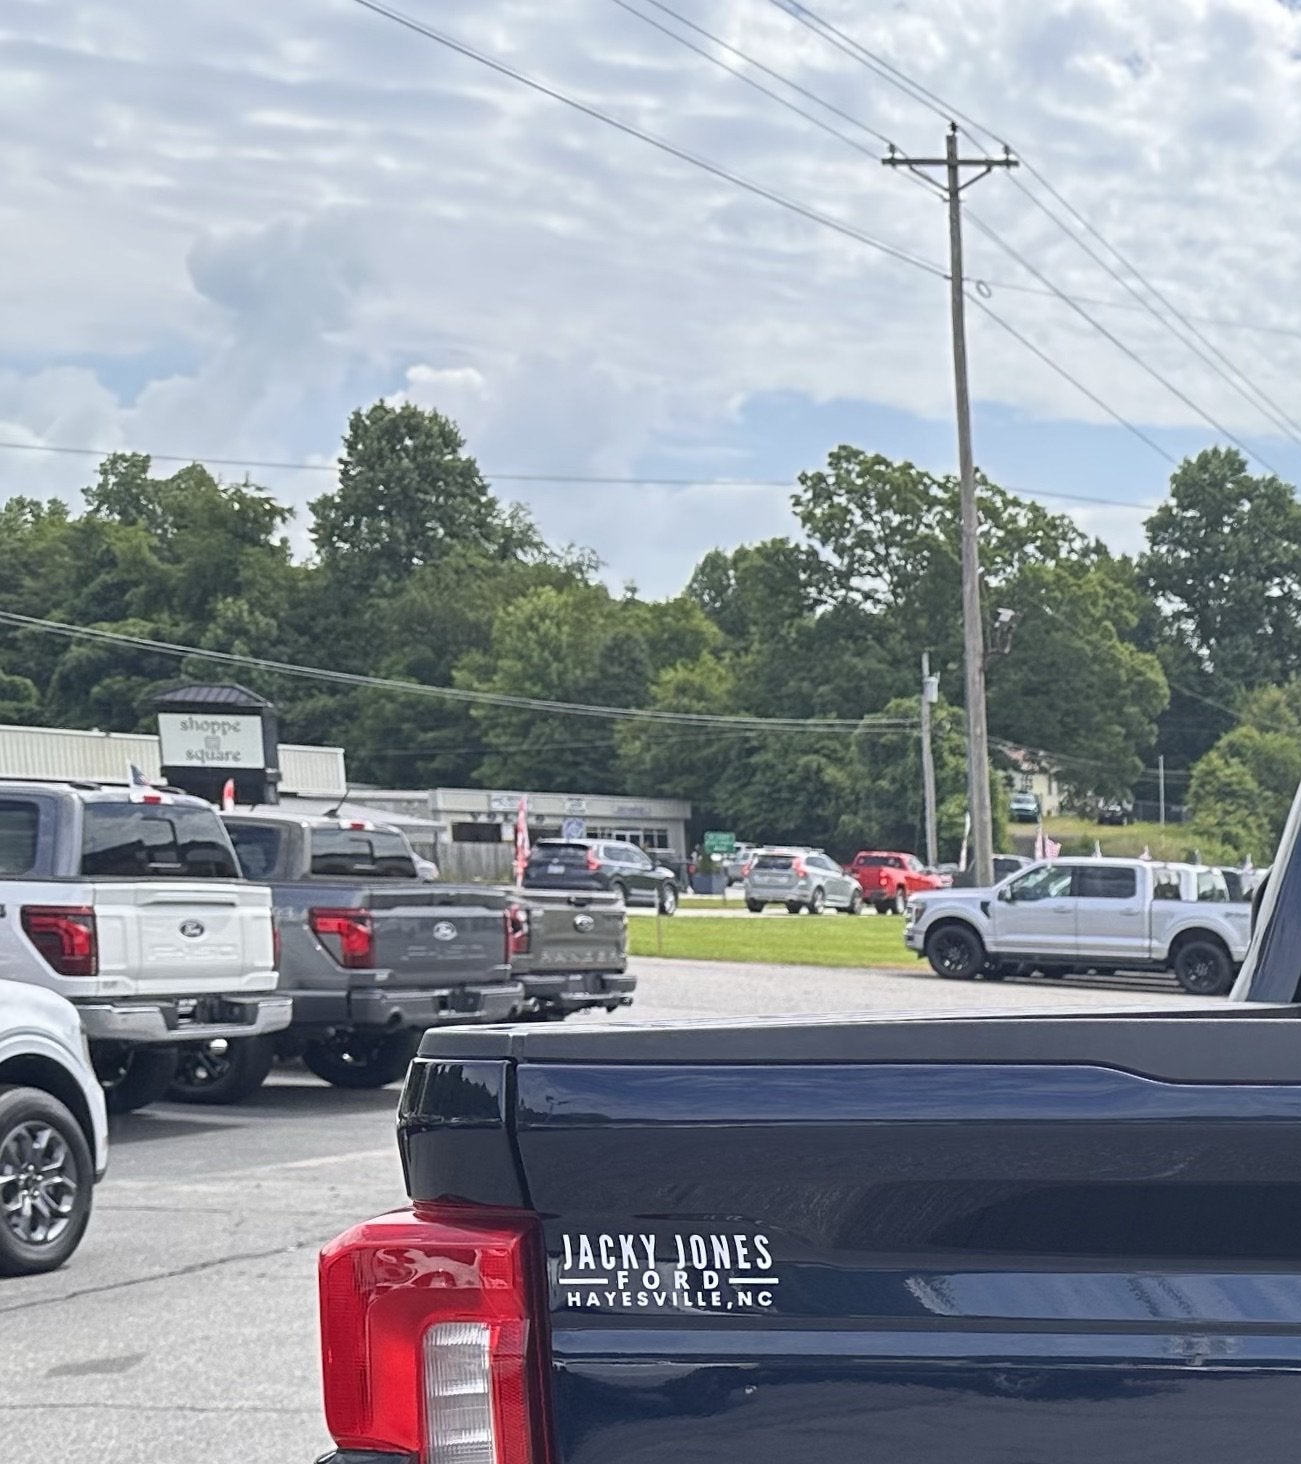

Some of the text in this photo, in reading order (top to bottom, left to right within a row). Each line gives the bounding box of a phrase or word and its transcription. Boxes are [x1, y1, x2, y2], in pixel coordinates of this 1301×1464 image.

[180, 717, 241, 735] shoppe
[185, 749, 241, 763] square
[562, 1234, 773, 1270] JACKY JONES
[616, 1270, 720, 1290] FORD
